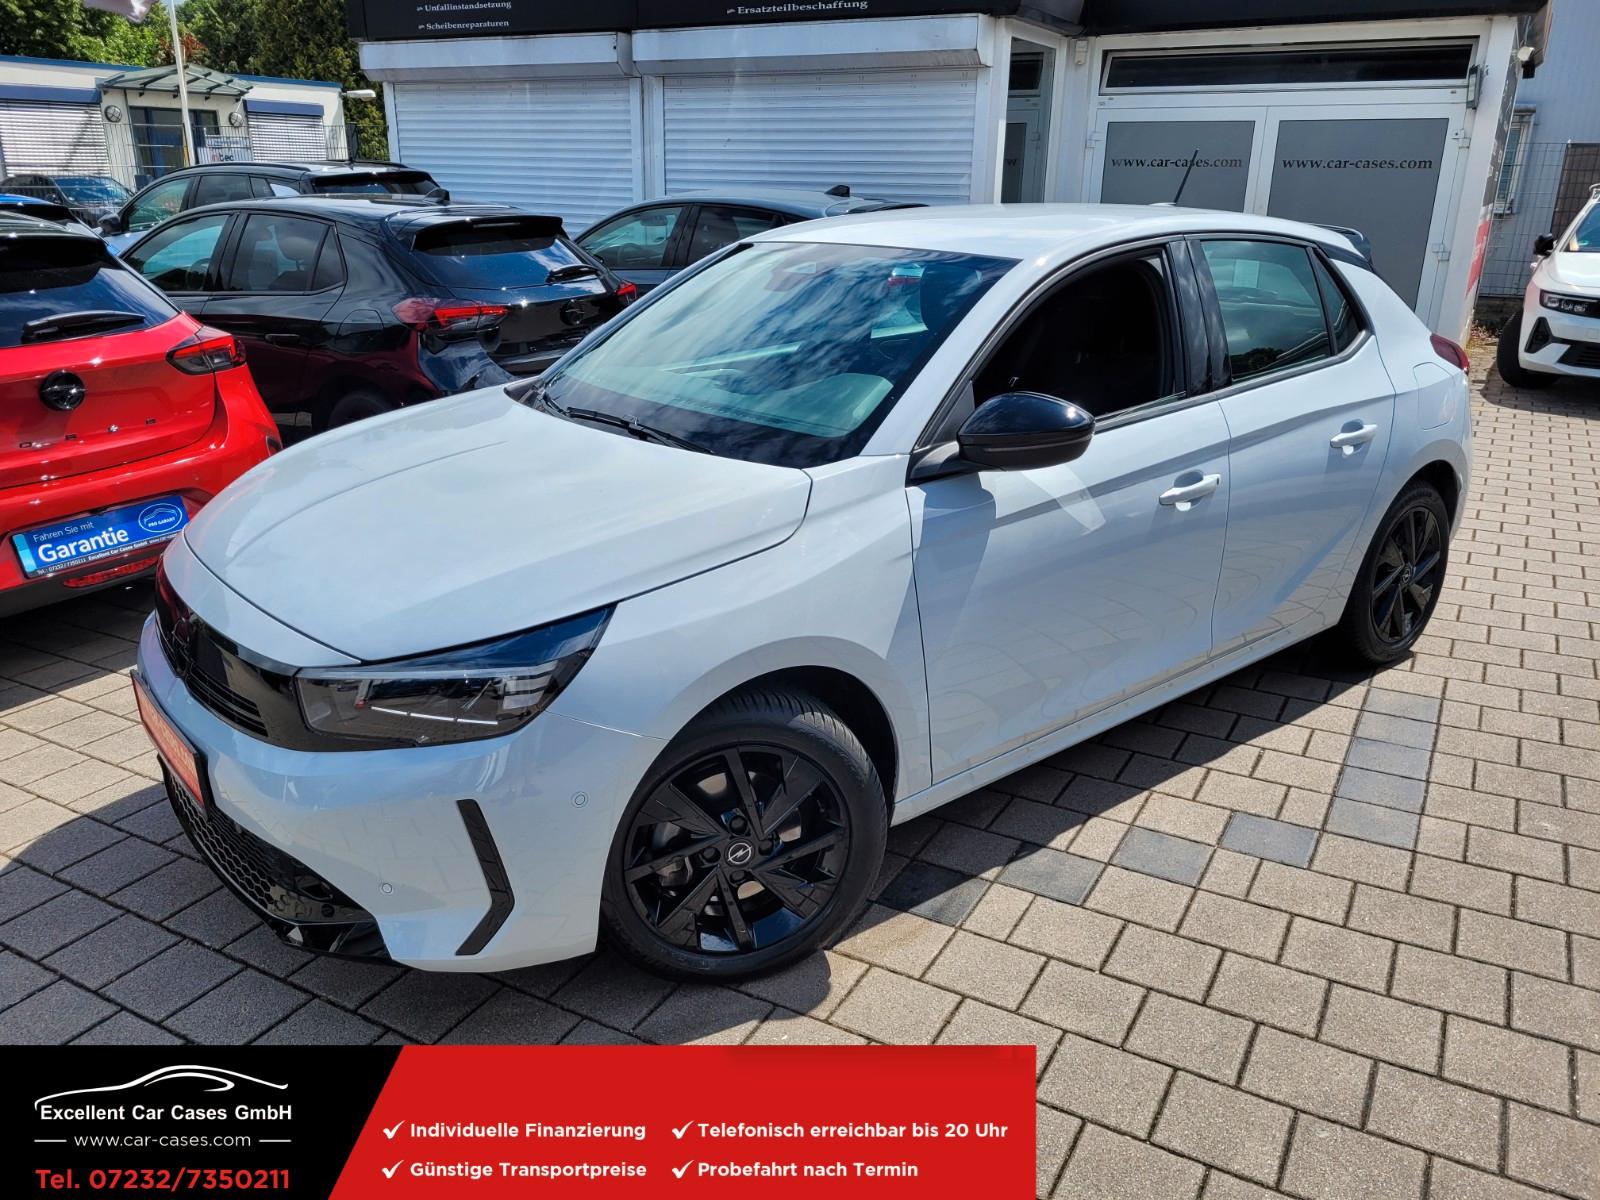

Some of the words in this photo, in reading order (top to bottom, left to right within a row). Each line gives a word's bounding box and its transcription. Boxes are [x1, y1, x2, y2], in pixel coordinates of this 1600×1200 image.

[424, 1, 512, 12] Unfallinstandsetzung
[737, 0, 869, 14] Ersatzteilbeschaffung
[426, 20, 510, 30] Scheibenreparaturen
[1282, 158, 1433, 169] www.car-cases.com
[33, 529, 64, 543] Fahren
[64, 526, 79, 537] Sie
[80, 521, 95, 535] mit
[38, 527, 130, 563] Garantie
